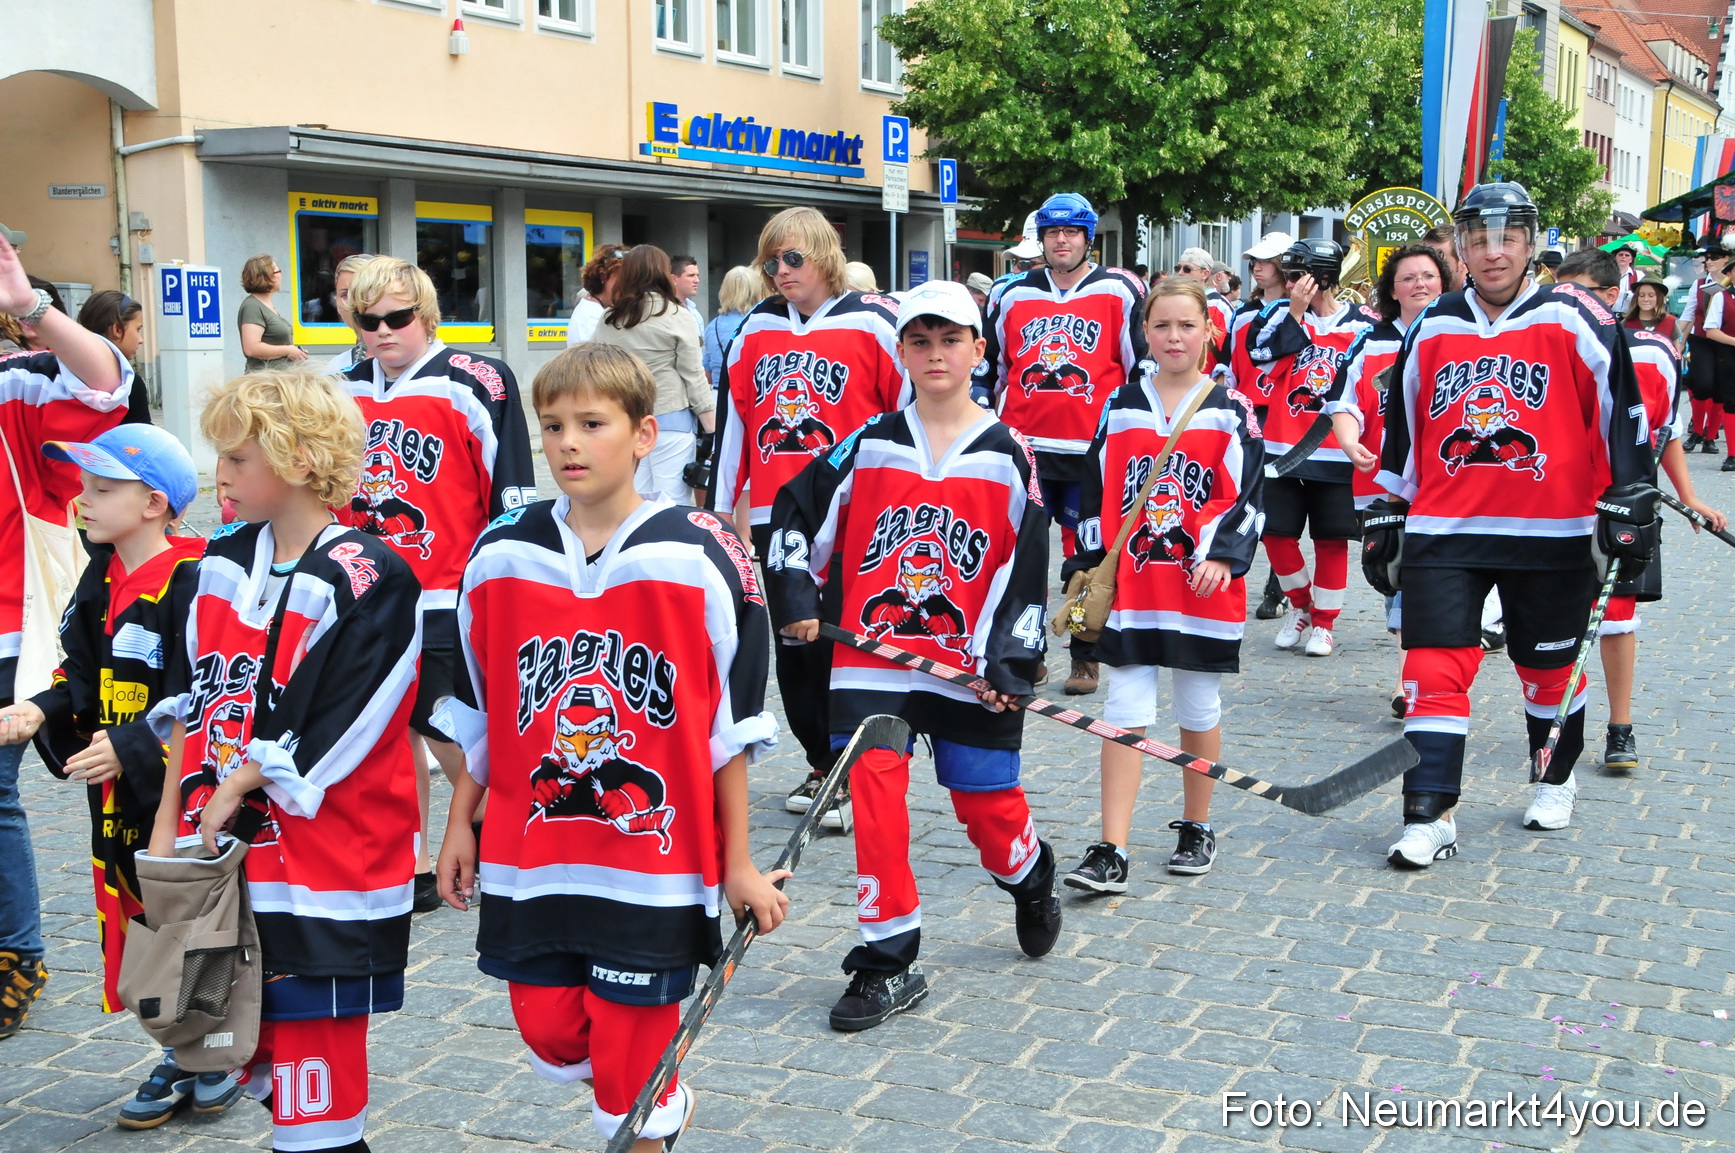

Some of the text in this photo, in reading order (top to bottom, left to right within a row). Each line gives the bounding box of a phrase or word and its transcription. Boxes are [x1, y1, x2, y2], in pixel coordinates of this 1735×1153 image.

[646, 101, 864, 165] E aktiv markt
[888, 122, 903, 157] P
[653, 146, 677, 155] EDEKA
[943, 165, 953, 198] P
[312, 199, 337, 209] aktiv
[339, 200, 369, 211] markt
[1347, 192, 1445, 229] Blaskapelle
[1366, 210, 1427, 238] Pilsach
[1385, 231, 1409, 242] 1954
[165, 274, 178, 297] P
[190, 275, 216, 287] HIER
[164, 301, 182, 314] SCHEINE
[197, 290, 211, 319] P
[190, 322, 220, 335] SCHEINE
[538, 329, 557, 337] aktiv
[1017, 313, 1102, 358] Eagles
[1429, 354, 1550, 420] Eagles
[767, 528, 812, 573] 42
[857, 502, 990, 582] Eagles
[517, 629, 678, 737] Eagles
[203, 1032, 234, 1048] PUMA
[272, 1056, 333, 1120] 10
